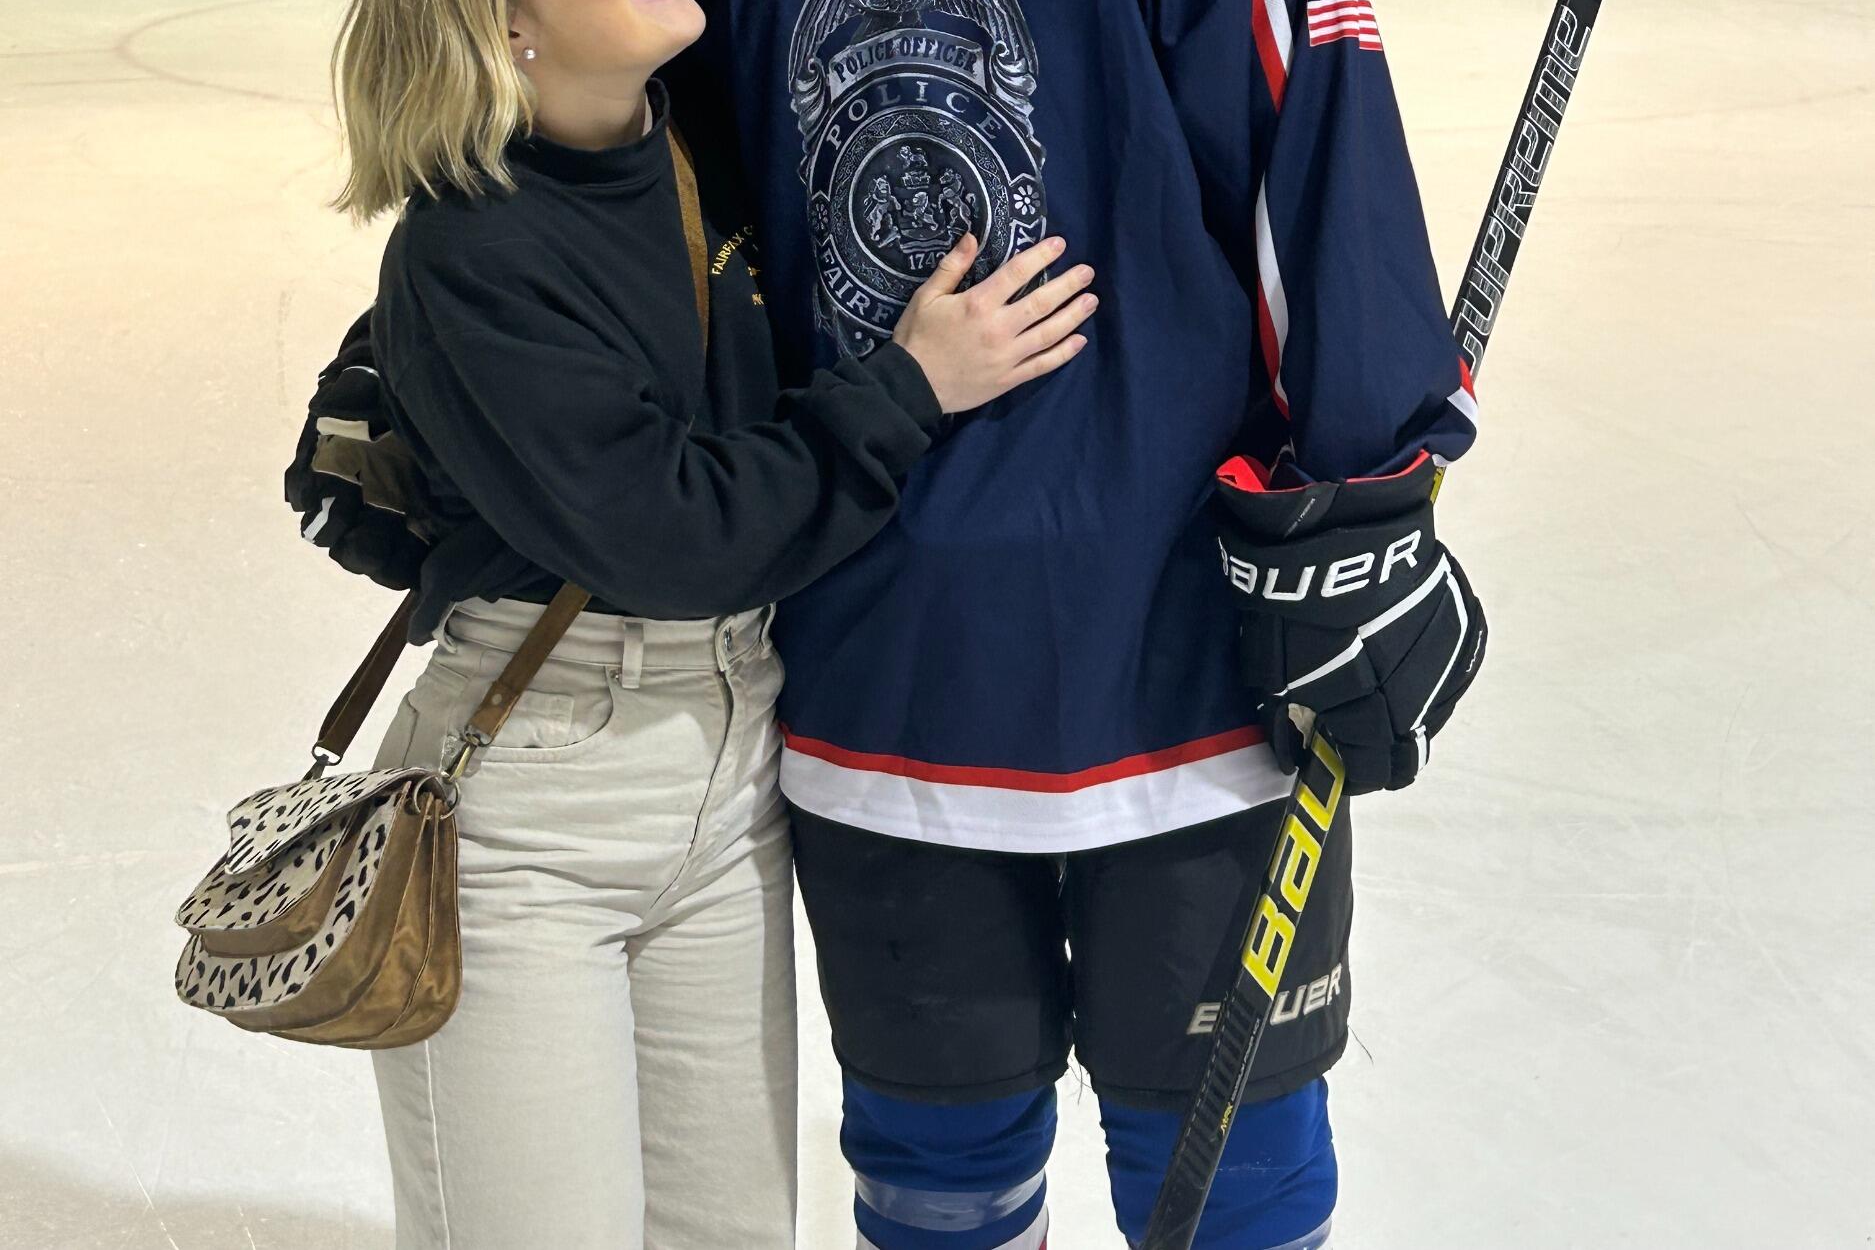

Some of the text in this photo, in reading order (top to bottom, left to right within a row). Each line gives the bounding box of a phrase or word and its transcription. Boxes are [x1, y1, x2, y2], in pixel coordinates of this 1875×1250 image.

[834, 36, 978, 83] POLICE OFFICER
[826, 80, 1003, 151] POLICE
[820, 248, 895, 323] FAIRF
[1186, 963, 1342, 1035] BUER
